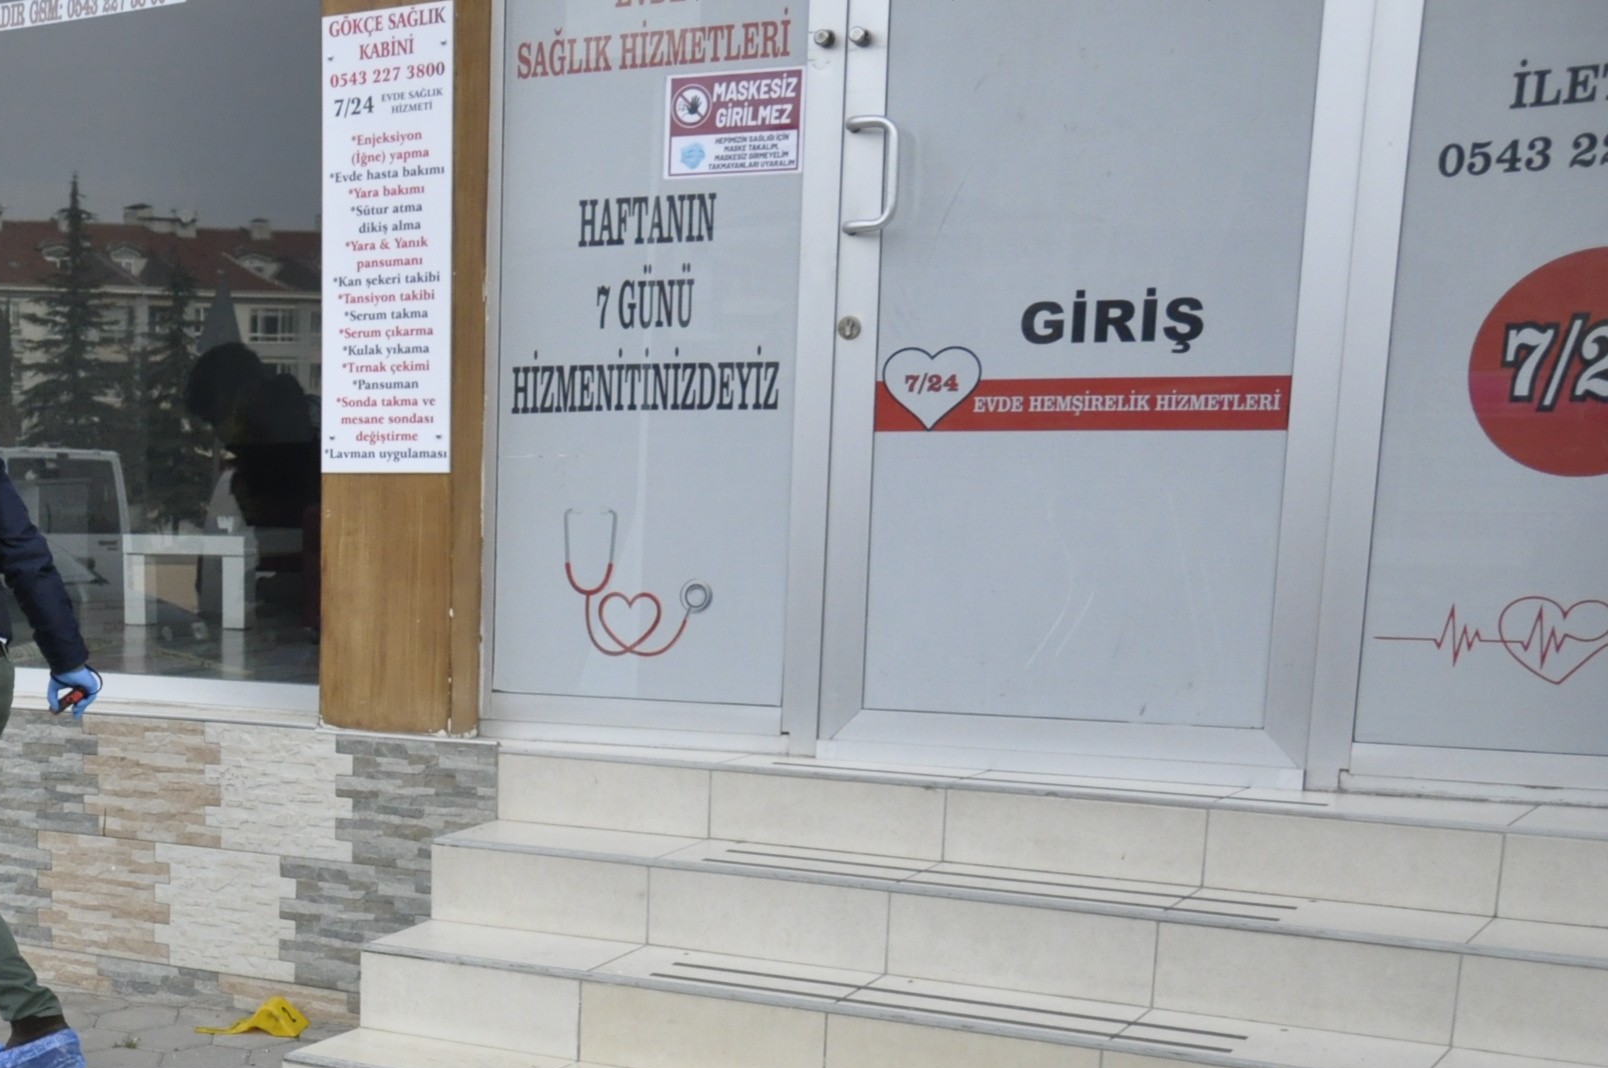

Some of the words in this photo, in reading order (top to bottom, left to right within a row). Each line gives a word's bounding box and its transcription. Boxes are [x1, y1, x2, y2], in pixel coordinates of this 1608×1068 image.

[328, 15, 384, 38] GÖKÇE
[388, 6, 446, 31] SAĞLIK
[359, 33, 414, 60] KABİNİ
[517, 27, 612, 80] SAĞLIK
[619, 7, 792, 70] HİZMETLERİ
[330, 70, 367, 88] 0543
[372, 66, 401, 83] 227
[406, 61, 445, 80] 3800
[712, 73, 798, 102] MASKESİZ
[1509, 59, 1608, 109] İLE
[381, 91, 405, 102] EVDE
[408, 87, 443, 99] SAĞLIK
[334, 95, 374, 118] 7/24
[391, 101, 433, 114] HİZMETİ
[715, 102, 793, 128] GİRİLMEZ
[351, 149, 386, 167] (İğne)
[389, 149, 430, 164] yapma
[1438, 136, 1552, 178] 0543
[366, 169, 399, 180] hasta
[402, 165, 445, 177] bakımı
[383, 184, 425, 197] bakımı
[392, 203, 423, 214] atma
[359, 221, 388, 234] dikiş
[392, 220, 421, 231] alma
[578, 193, 717, 247] HAFTANIN
[379, 239, 390, 249] &
[394, 237, 428, 249] Yanık
[356, 257, 423, 272] pansumanı
[365, 273, 401, 288] şekeri
[405, 271, 440, 283] takibi
[400, 289, 435, 301] takibi
[597, 285, 611, 329] 7
[618, 263, 694, 329] GÜNÜ
[391, 308, 428, 319] takma
[1021, 287, 1204, 354] GİRİŞ
[385, 326, 434, 340] çıkarma
[386, 343, 430, 359] yıkama
[390, 360, 430, 374] çekimi
[1501, 313, 1608, 412] 7/2
[511, 346, 780, 414] HİZMENİTİNİZDEYİZ
[904, 373, 959, 394] 7/24
[381, 396, 418, 407] takma
[422, 398, 436, 406] ve
[973, 396, 1024, 414] EVDE
[1028, 390, 1150, 416] HEMŞİRELİK
[1155, 389, 1281, 412] HİZMETLERİ
[341, 415, 385, 424] mesane
[388, 413, 434, 424] sondası
[355, 431, 418, 445] değiştirme
[379, 448, 447, 462] uygulaması
